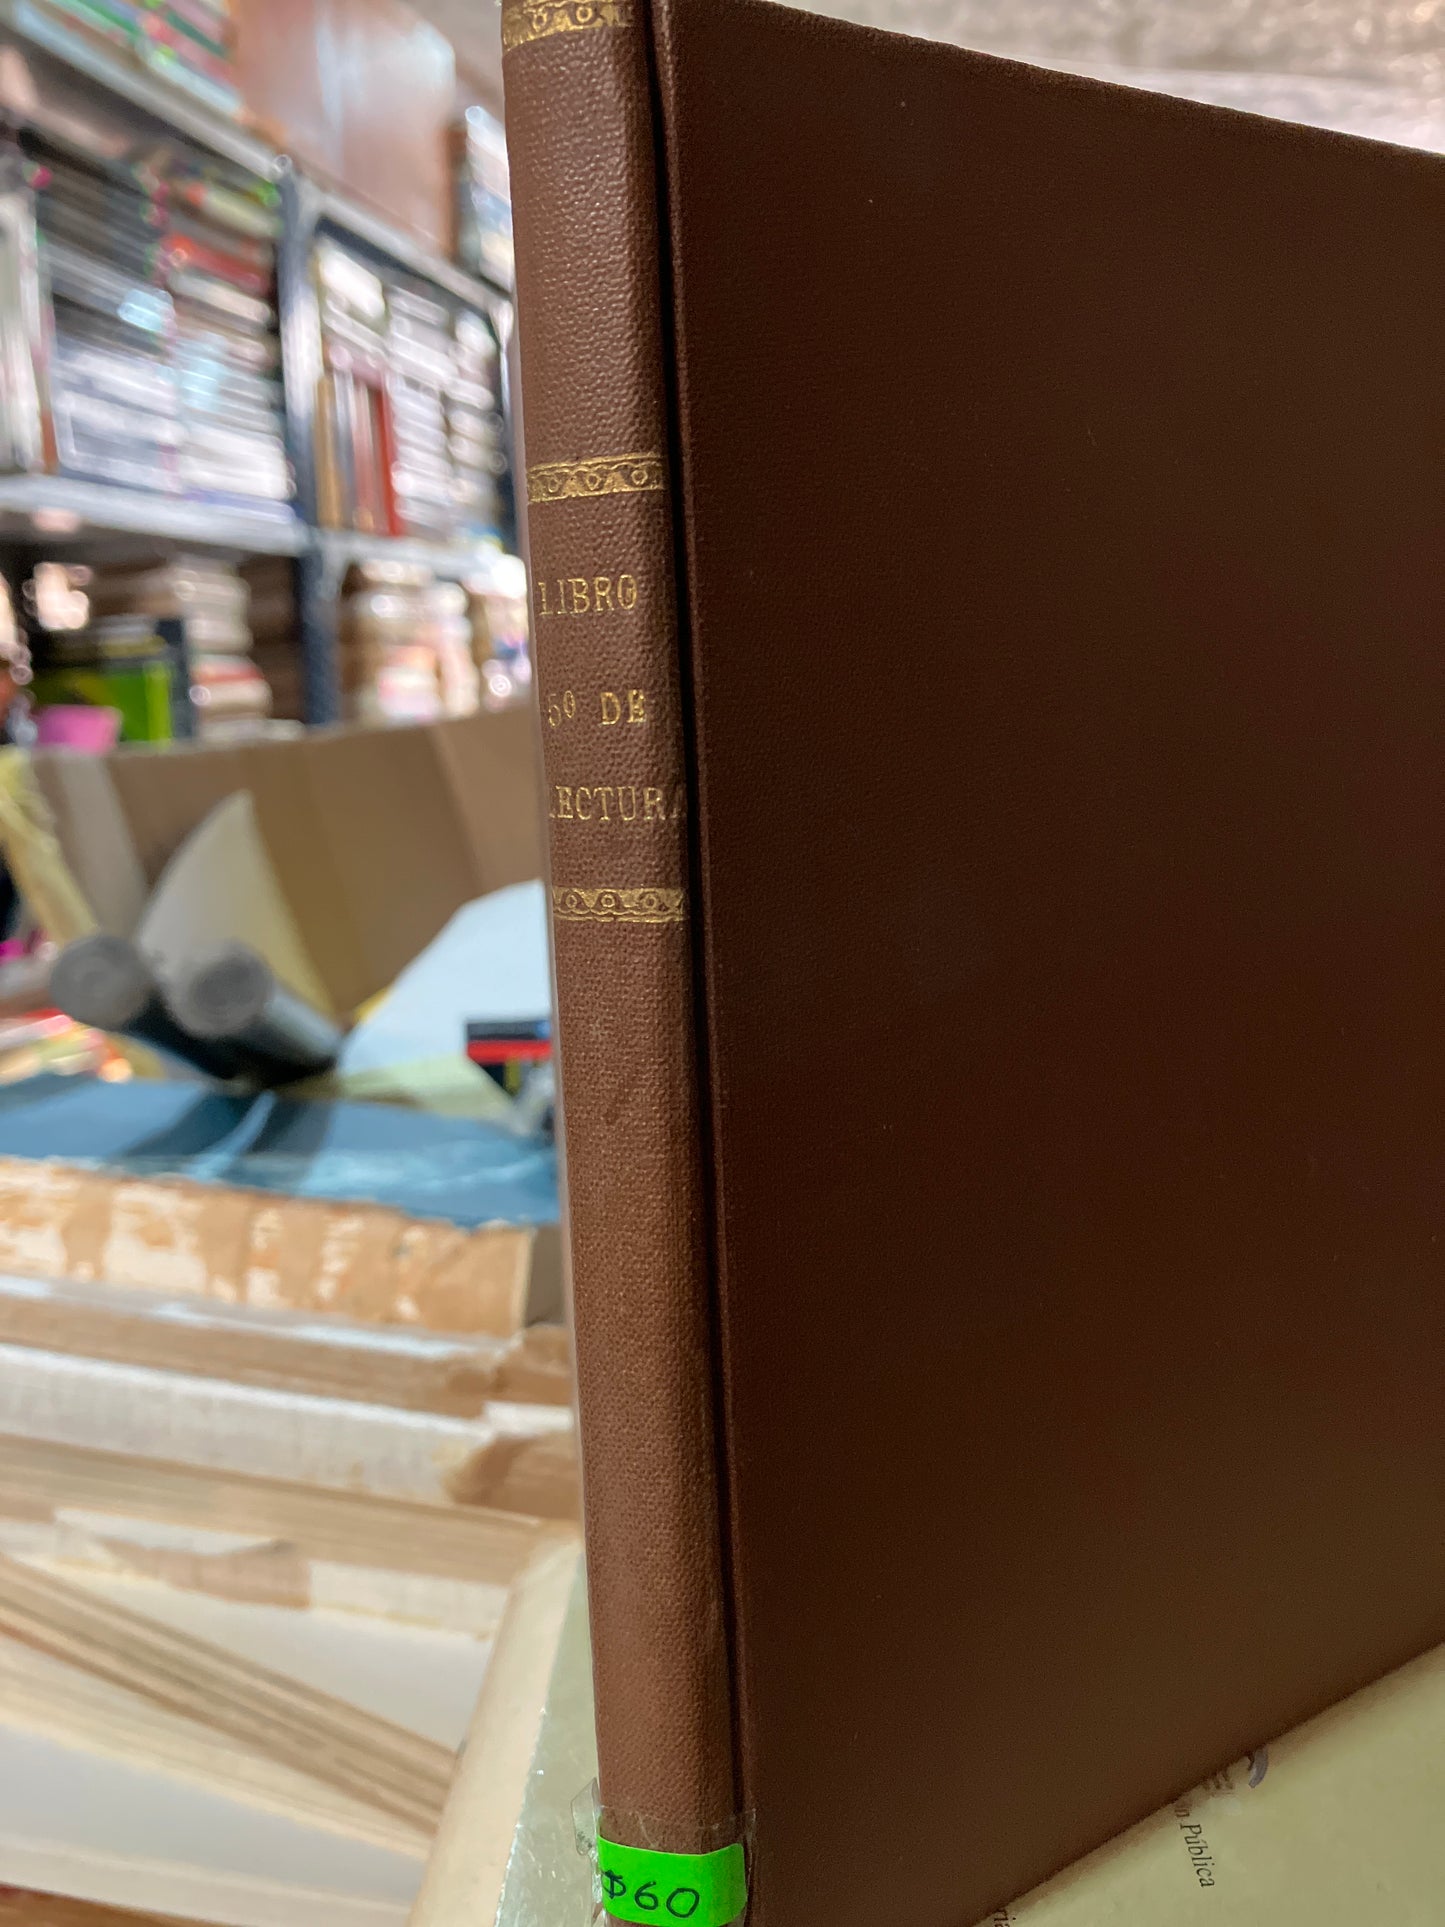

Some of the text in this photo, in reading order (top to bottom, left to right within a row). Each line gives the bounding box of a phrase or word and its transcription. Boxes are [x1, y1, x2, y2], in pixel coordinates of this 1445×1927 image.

[538, 574, 637, 615] LIBRO
[600, 689, 646, 725] DE
[1180, 1823, 1216, 1888] Pública
[600, 1869, 700, 1918] $60
